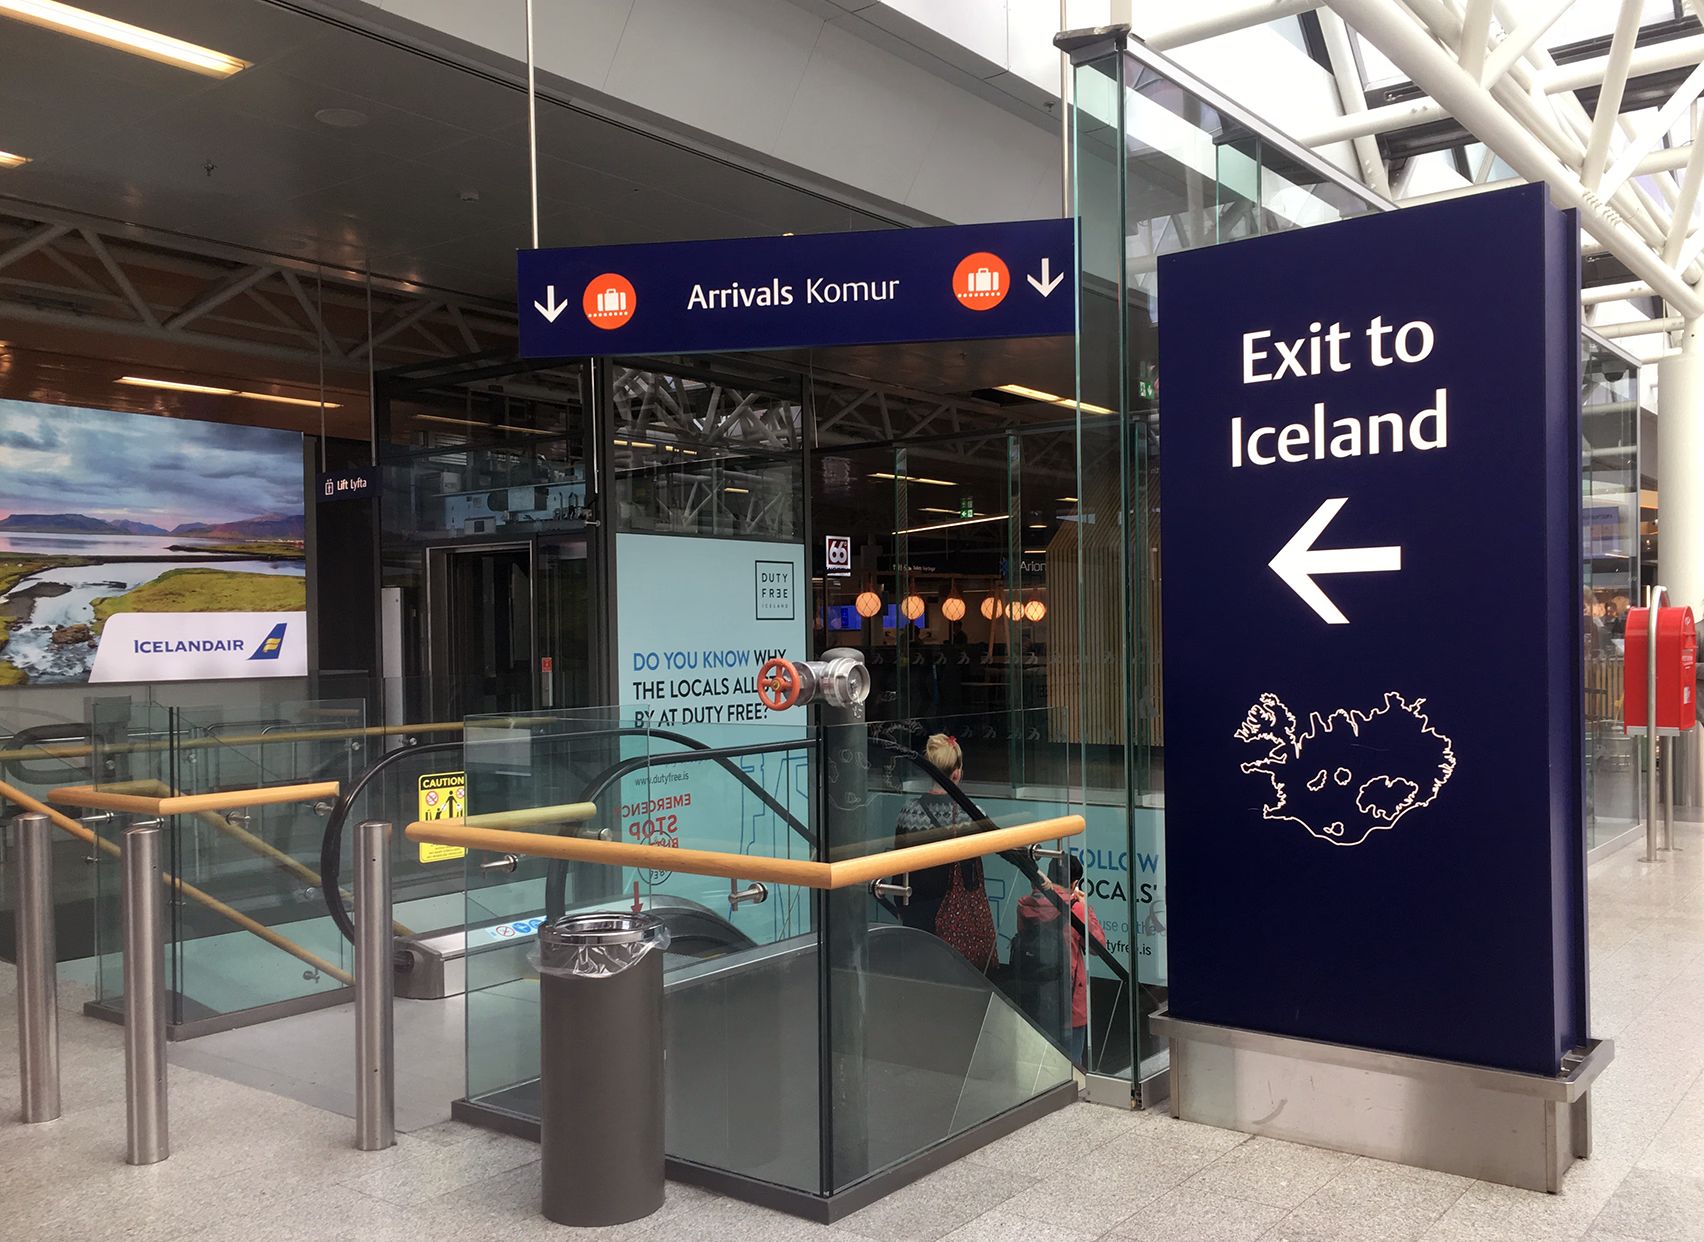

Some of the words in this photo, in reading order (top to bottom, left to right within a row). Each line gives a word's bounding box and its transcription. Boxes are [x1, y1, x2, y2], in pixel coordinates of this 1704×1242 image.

[687, 277, 793, 308] Arrivals
[806, 278, 899, 303] Komur
[1242, 321, 1351, 385] Exit
[1366, 315, 1435, 368] to
[1230, 387, 1448, 468] Iceland
[336, 478, 349, 492] Lift
[350, 475, 368, 492] Lyfta
[761, 572, 789, 583] DUTY
[1019, 560, 1047, 573] Arion
[134, 639, 245, 654] ICELANDAIR
[633, 651, 660, 672] DO
[664, 651, 698, 671] YOU
[703, 649, 751, 669] KNOW
[753, 648, 787, 667] WHY
[633, 681, 666, 701] THE
[670, 677, 730, 698] LOCALS
[733, 675, 760, 695] ALL
[634, 709, 656, 730] BY
[657, 708, 678, 728] AT
[682, 706, 724, 726] DUTY
[727, 702, 770, 722] FREE?
[422, 776, 465, 790] CAUTION
